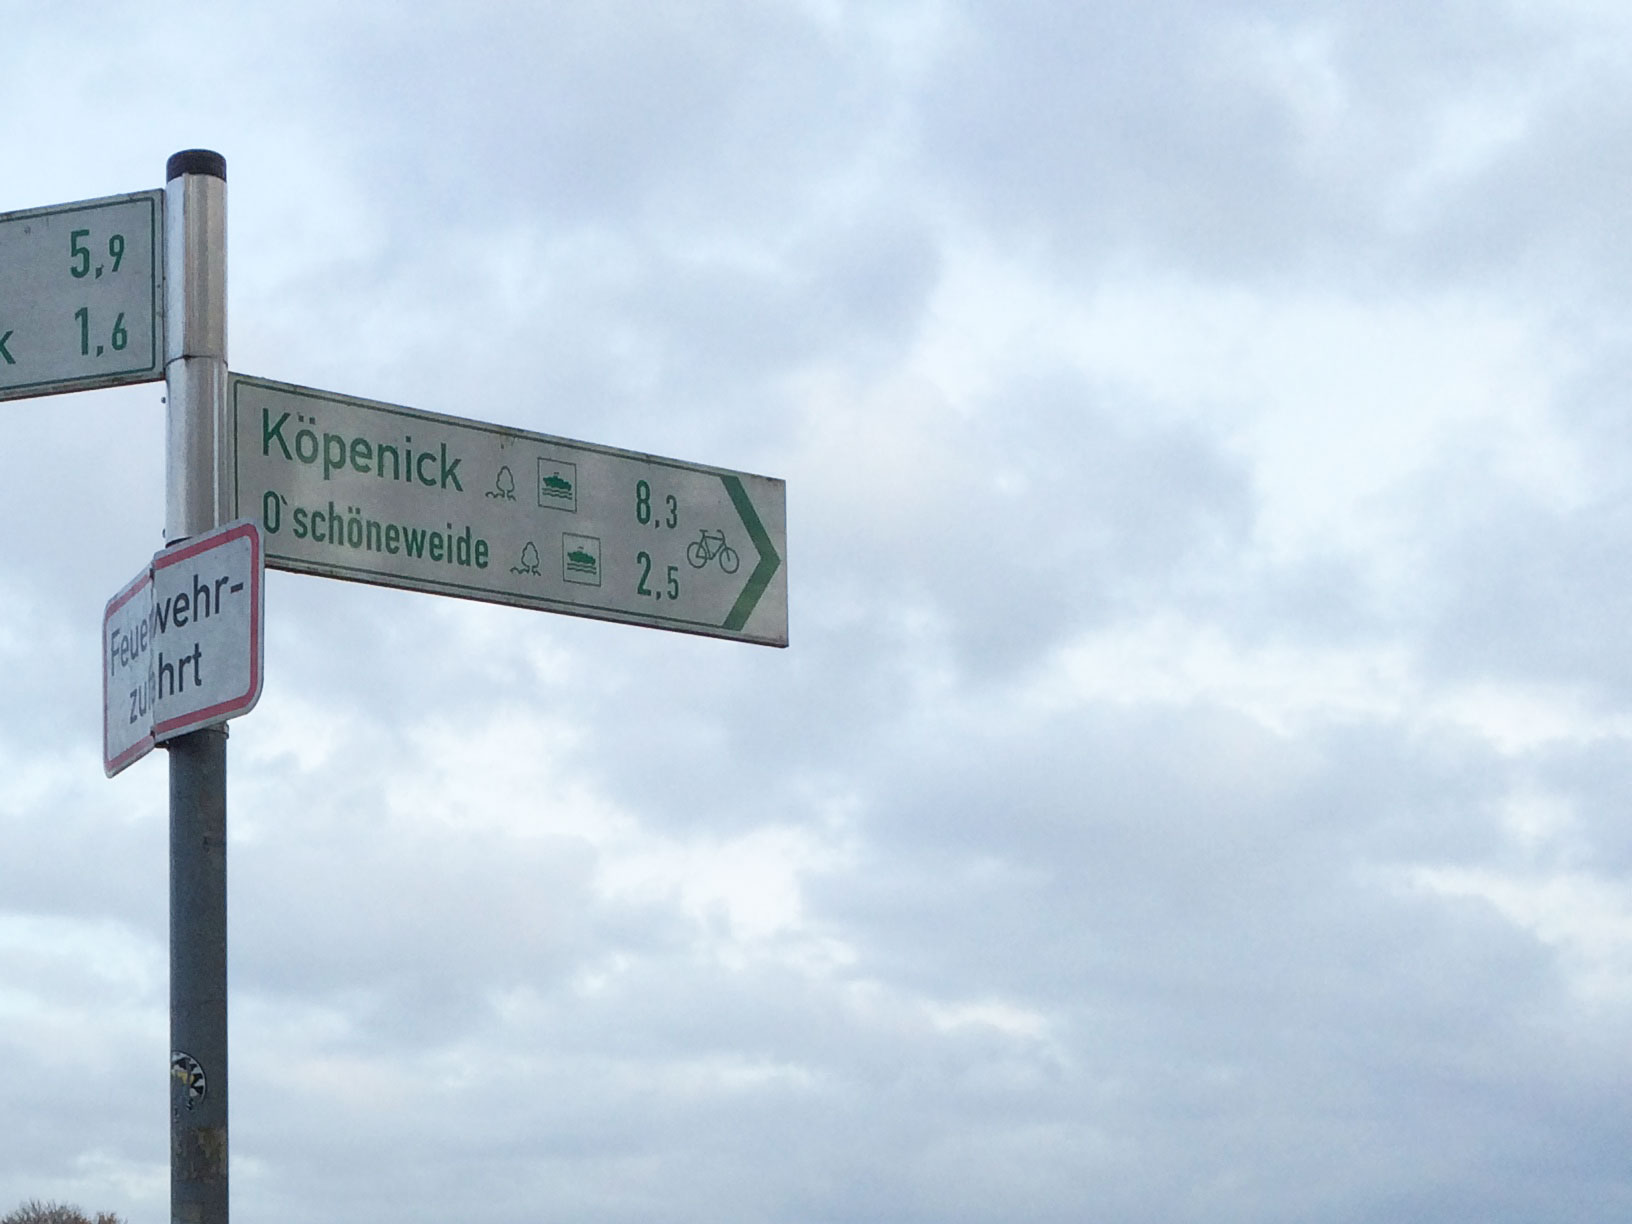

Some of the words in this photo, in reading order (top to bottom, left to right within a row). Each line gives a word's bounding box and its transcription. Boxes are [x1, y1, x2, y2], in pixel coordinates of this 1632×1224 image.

[70, 229, 125, 280] 5,9
[75, 307, 128, 356] 1,6
[262, 407, 464, 492] Köpenick
[636, 479, 678, 530] 8,3
[637, 551, 680, 601] 2,5
[110, 574, 244, 676] Feuewehr-
